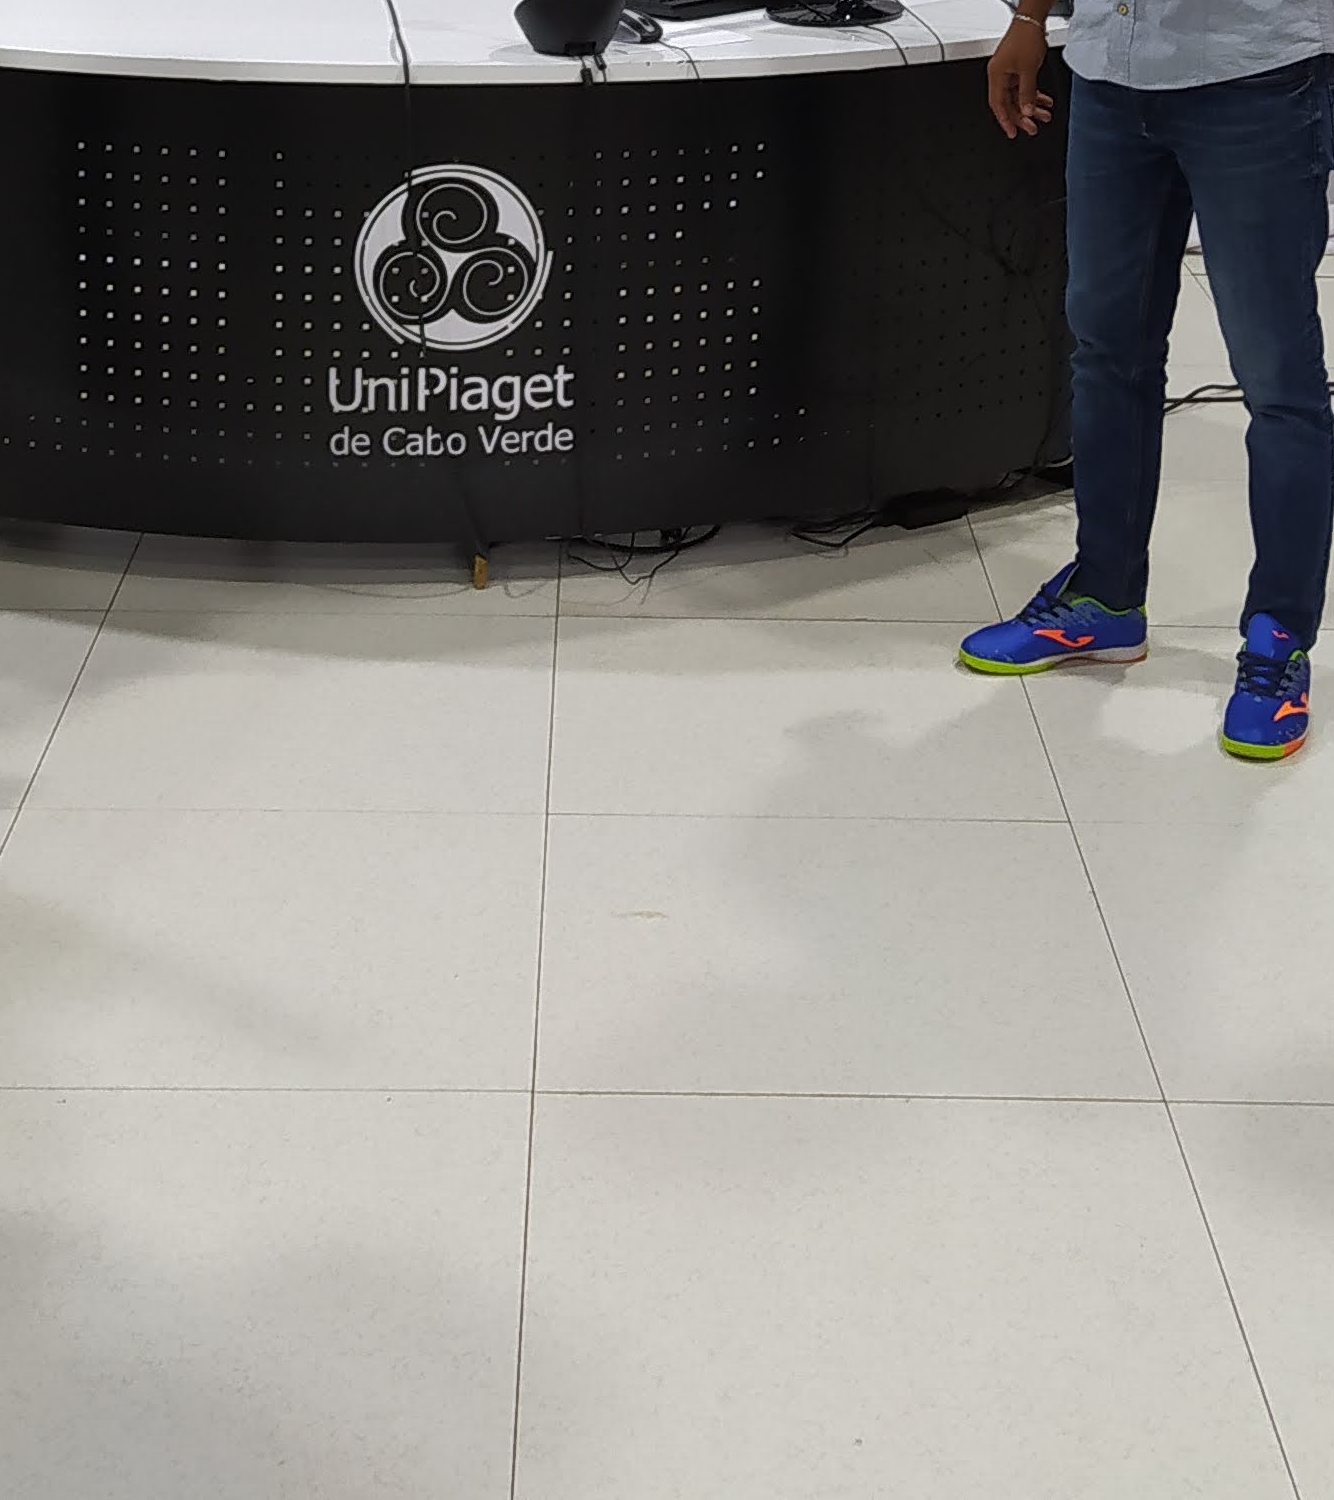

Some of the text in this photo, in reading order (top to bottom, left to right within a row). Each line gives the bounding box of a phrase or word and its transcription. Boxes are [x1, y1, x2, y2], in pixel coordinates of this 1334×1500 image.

[328, 365, 574, 421] UniPiaget
[330, 422, 574, 456] de Cabo Verde
